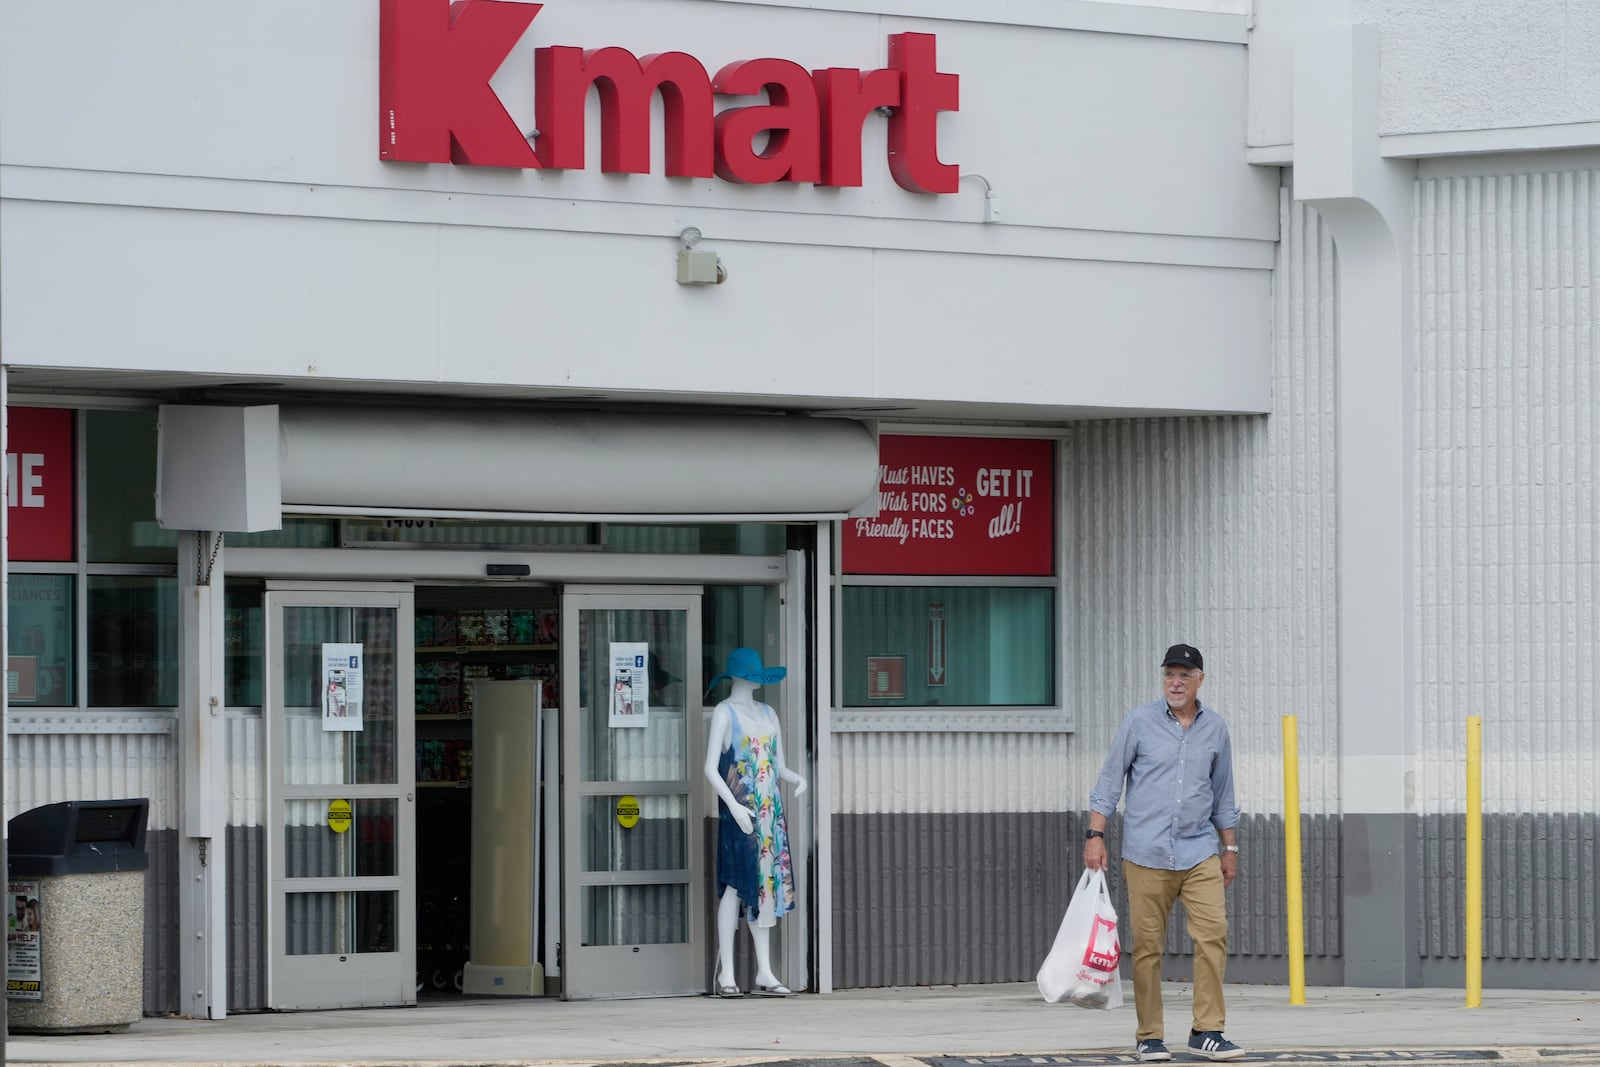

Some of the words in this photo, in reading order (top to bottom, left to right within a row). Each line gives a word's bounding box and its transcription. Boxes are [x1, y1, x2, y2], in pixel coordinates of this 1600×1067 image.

[380, 0, 959, 194] Kmart
[911, 466, 955, 486] HAVES
[976, 468, 1012, 497] GET
[1016, 469, 1033, 498] IT
[879, 491, 910, 511] Wish
[911, 492, 947, 512] FORS
[855, 517, 910, 545] Friendly
[911, 518, 954, 539] FACES
[988, 501, 1023, 539] all!
